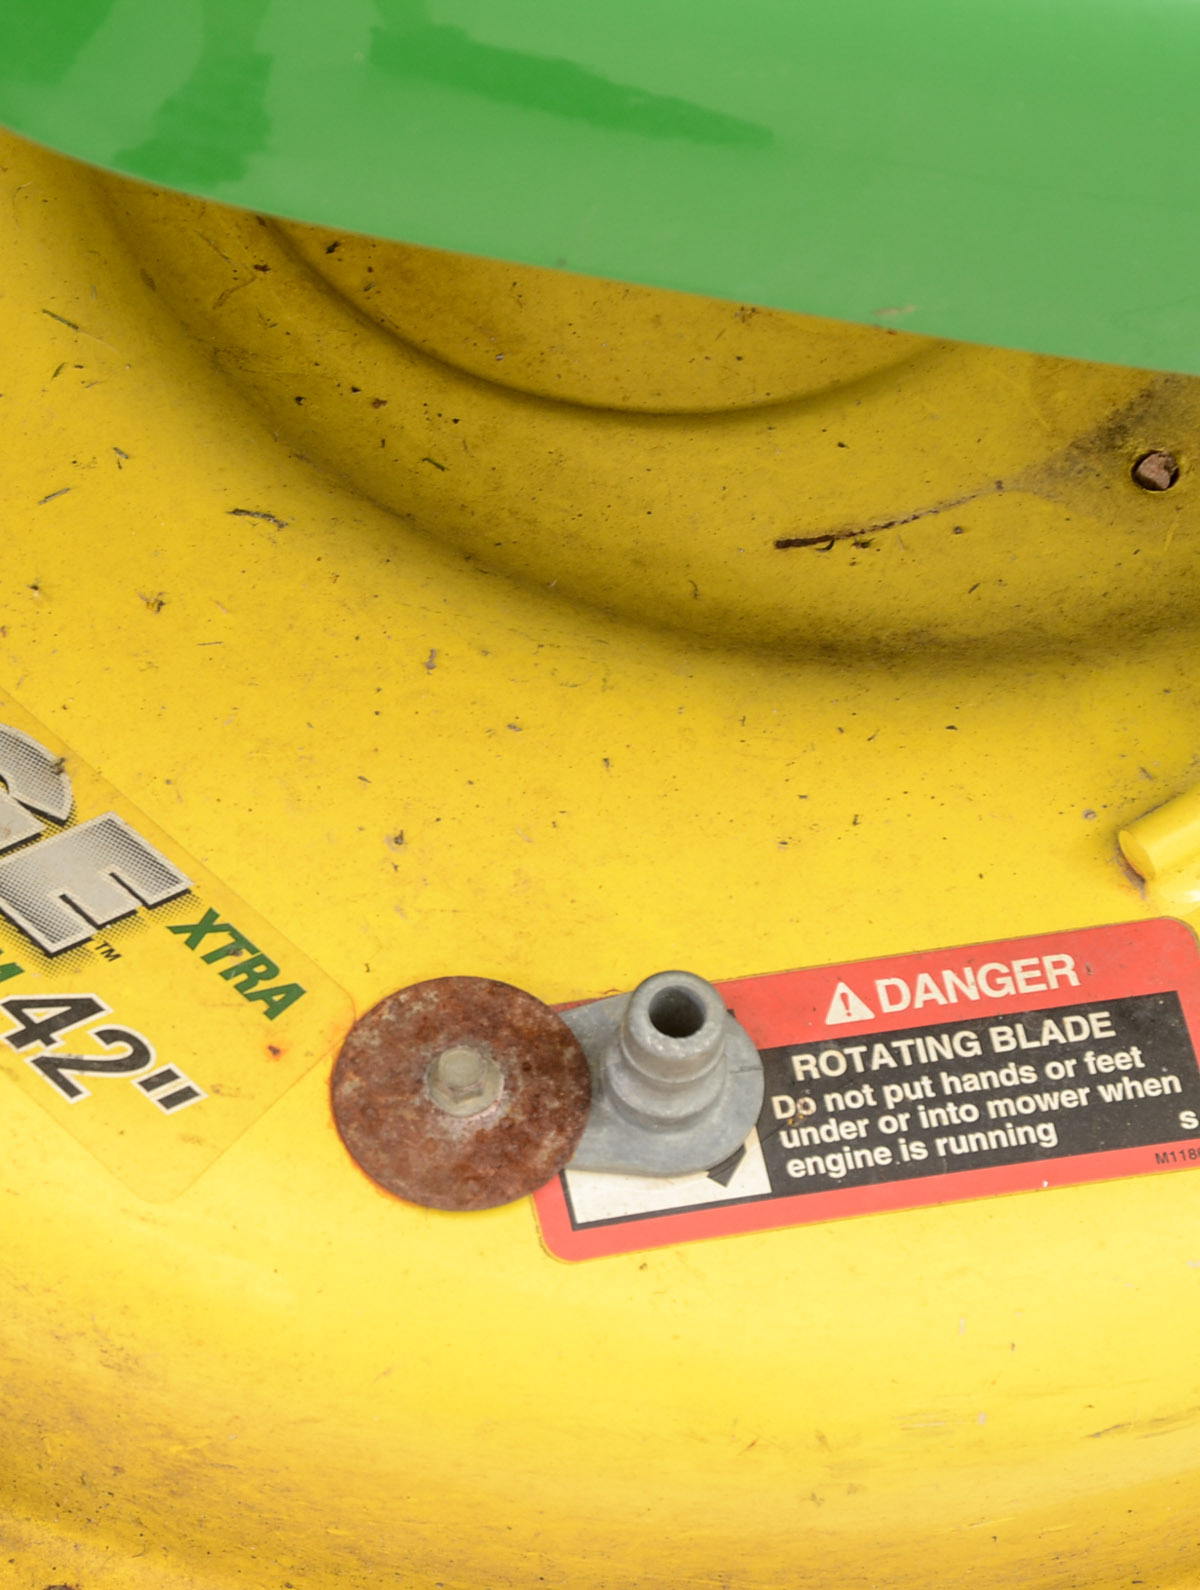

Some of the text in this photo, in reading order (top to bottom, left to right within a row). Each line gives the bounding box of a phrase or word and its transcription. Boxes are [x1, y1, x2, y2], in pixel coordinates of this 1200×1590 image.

[167, 907, 307, 1021] XTRA
[875, 953, 1081, 1013] DANGER
[791, 1011, 1117, 1081] ROTATING BLADE
[771, 1046, 1145, 1119] Do not put hands or feet
[779, 1074, 1183, 1149] under or into mower when
[786, 1121, 1058, 1178] engine is running
